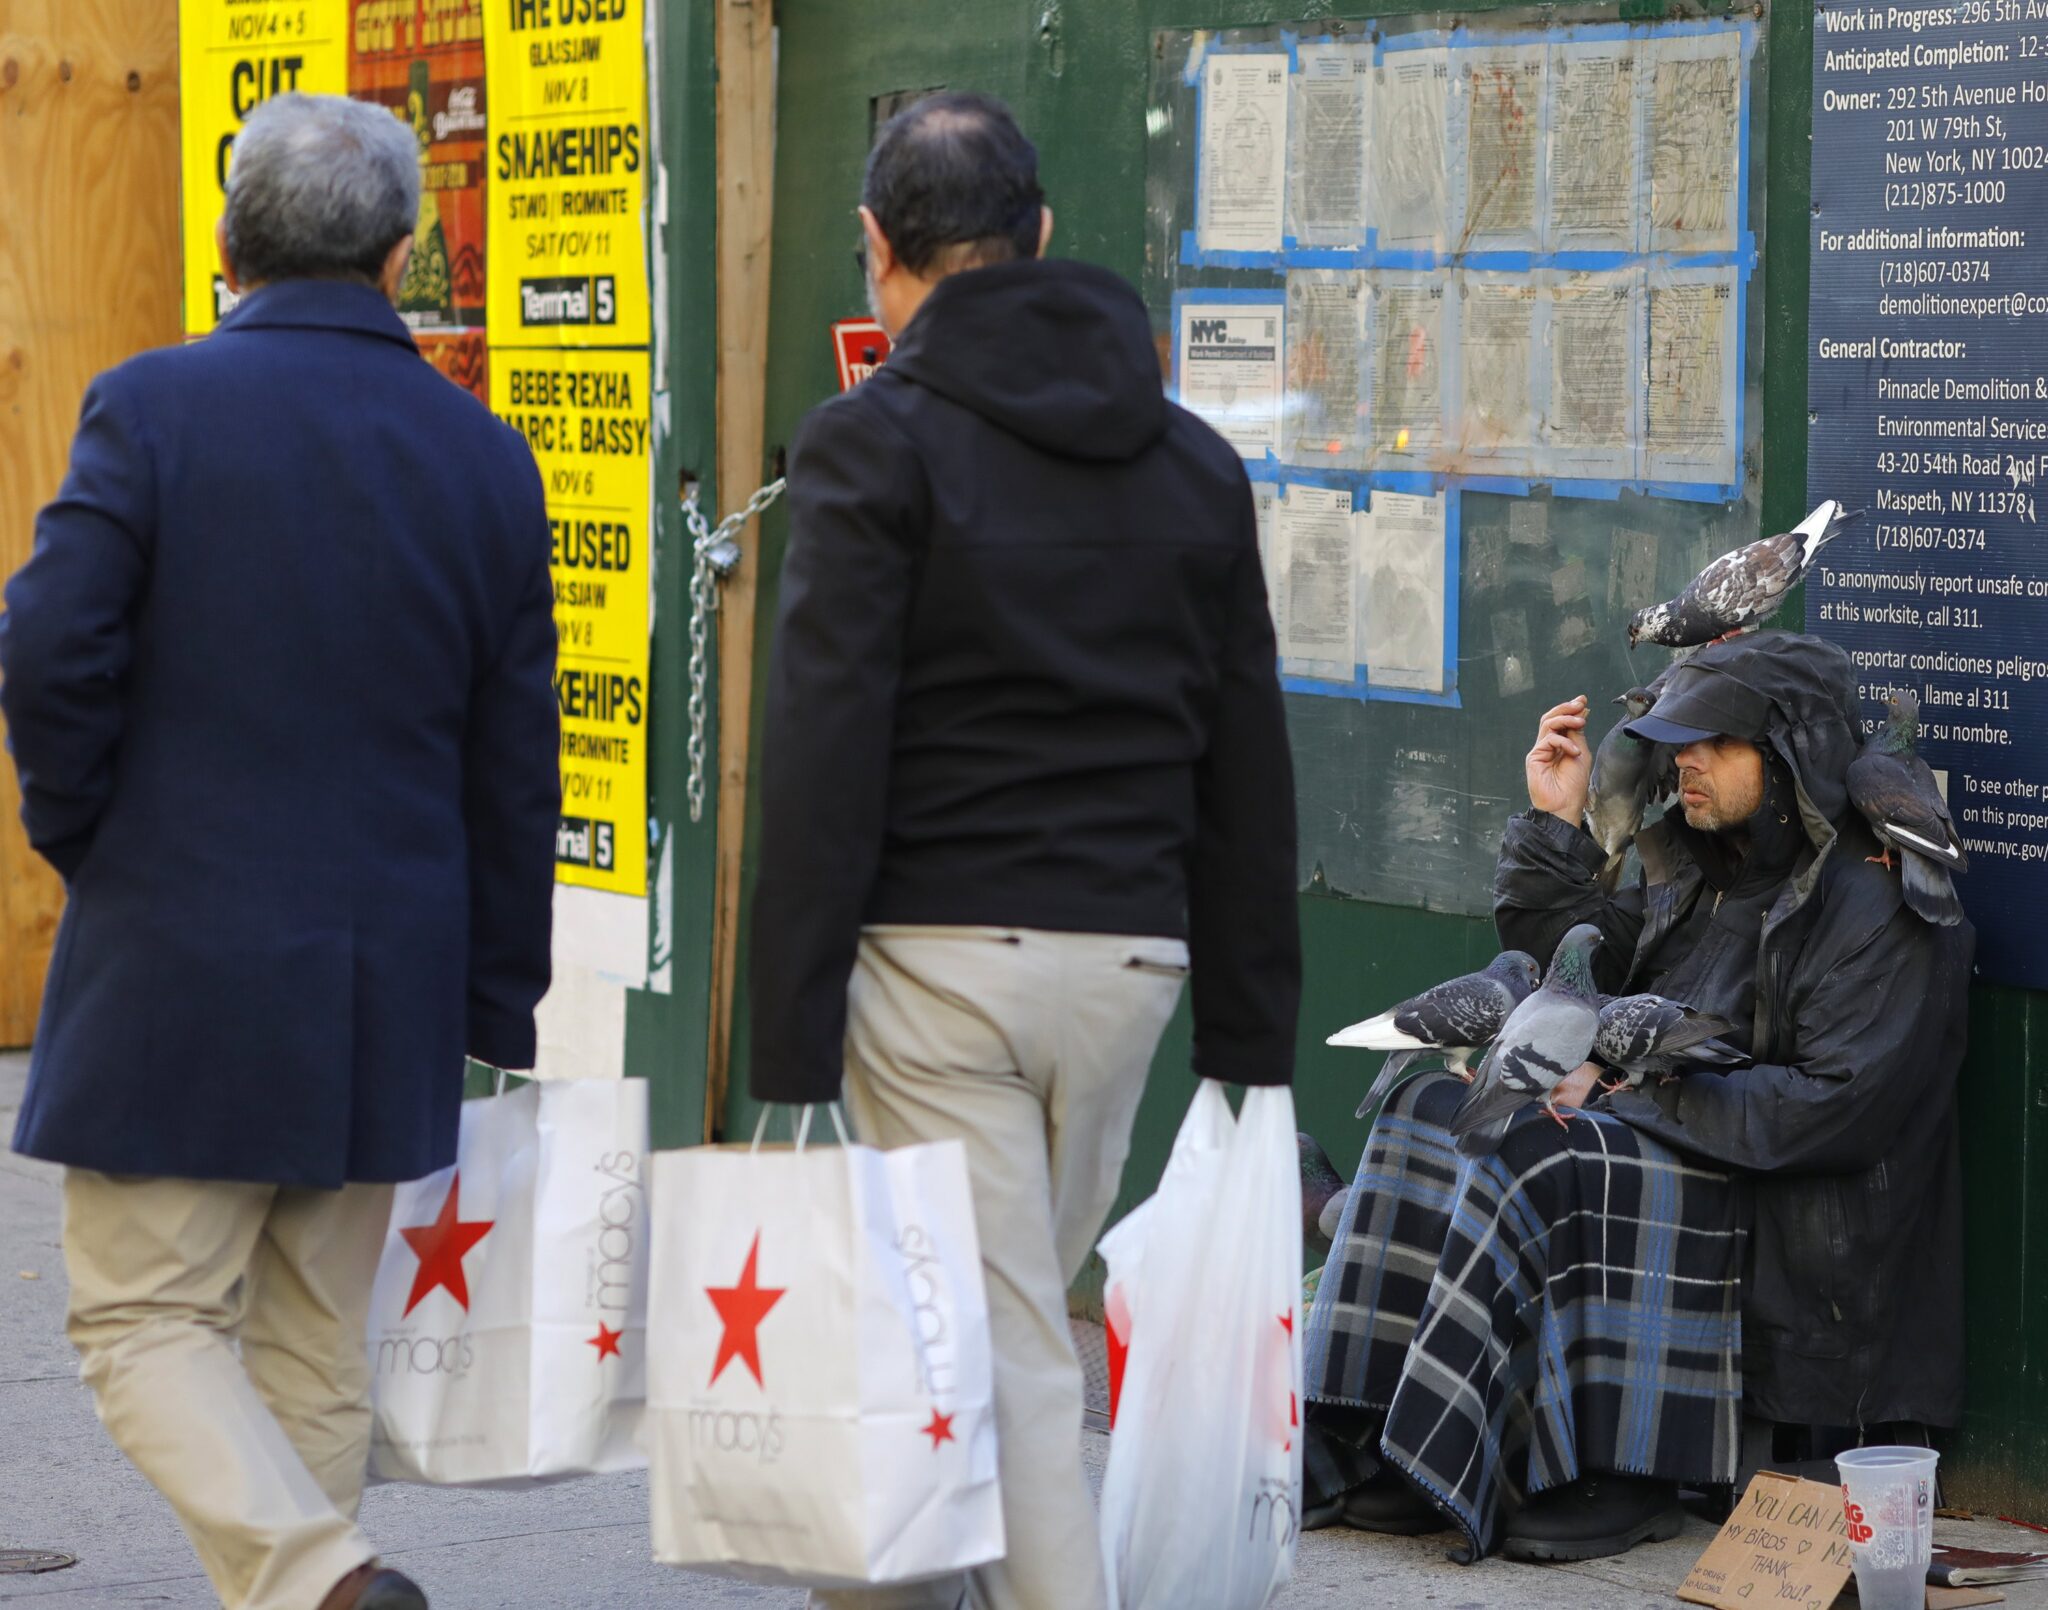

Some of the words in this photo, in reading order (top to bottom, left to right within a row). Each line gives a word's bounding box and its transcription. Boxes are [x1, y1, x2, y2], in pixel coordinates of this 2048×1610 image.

[229, 13, 267, 41] NOV
[1826, 9, 1865, 33] Work
[1869, 11, 1883, 30] in
[1887, 7, 1957, 33] Progress:
[1962, 1, 1990, 24] 296
[1995, 0, 2020, 21] 5th
[1824, 45, 1909, 74] Anticipated
[1914, 41, 2009, 70] Completion:
[543, 78, 577, 105] NOV
[580, 76, 588, 102] 8
[1823, 90, 1881, 112] Owner:
[1887, 87, 1916, 110] 292
[1921, 84, 1948, 108] 5th
[1953, 83, 2016, 106] Avenue
[1886, 119, 1915, 142] 201
[1921, 118, 1938, 140] W
[1943, 116, 1980, 140] 79th
[1985, 115, 2007, 141] St,
[498, 124, 640, 181] SNAKEHIPS
[1886, 152, 1921, 174] New
[1926, 149, 1965, 176] York,
[1972, 148, 1996, 171] NY
[1885, 180, 2005, 212] (212)875-1000
[1820, 230, 1844, 251] For
[1847, 227, 1922, 251] additional
[1926, 226, 2026, 249] information:
[1880, 260, 1990, 288] (718)607-0374
[597, 280, 614, 321] 5
[1191, 320, 1227, 343] NYC
[1819, 337, 1876, 359] General
[1880, 337, 1967, 359] Contractor:
[510, 370, 562, 406] BEBE
[1878, 378, 1940, 400] Pinnacle
[1945, 378, 2030, 400] Demolition
[2035, 377, 2048, 399] &
[581, 417, 646, 456] BASSY
[1878, 415, 1986, 438] Environmental
[1877, 452, 1919, 474] 43-20
[1923, 452, 1958, 475] 54th
[1963, 453, 2000, 476] Road
[2005, 454, 2035, 477] 2nd
[551, 469, 581, 494] NOV
[584, 470, 594, 495] 6
[1877, 489, 1946, 515] Maspeth,
[1951, 491, 1973, 513] NY
[1978, 492, 2026, 514] 11378
[1877, 524, 1986, 552] (718)607-0374
[1820, 567, 1835, 586] To
[1839, 570, 1926, 594] anonymously
[1930, 573, 1973, 597] report
[1977, 574, 2023, 596] unsafe
[1820, 604, 1832, 620] at
[1836, 602, 1860, 622] this
[1863, 604, 1923, 628] worksite,
[1927, 606, 1950, 627] call
[1953, 608, 1983, 628] 311.
[1851, 650, 1907, 671] reportar
[1910, 650, 1993, 674] condiciones
[1925, 684, 1963, 706] llame
[1967, 687, 1980, 708] al
[1983, 690, 2009, 710] 311
[1933, 724, 1948, 740] su
[1952, 723, 2012, 745] nombre.
[1963, 775, 1977, 792] To
[1981, 780, 2001, 795] see
[2004, 778, 2039, 798] other
[1963, 808, 1978, 823] on
[1982, 805, 2004, 825] this
[597, 825, 612, 866] 5
[1745, 1489, 1787, 1521] YOU
[1787, 1502, 1829, 1530] CAN
[1724, 1524, 1746, 1540] MY
[1751, 1554, 1793, 1579] THANK
